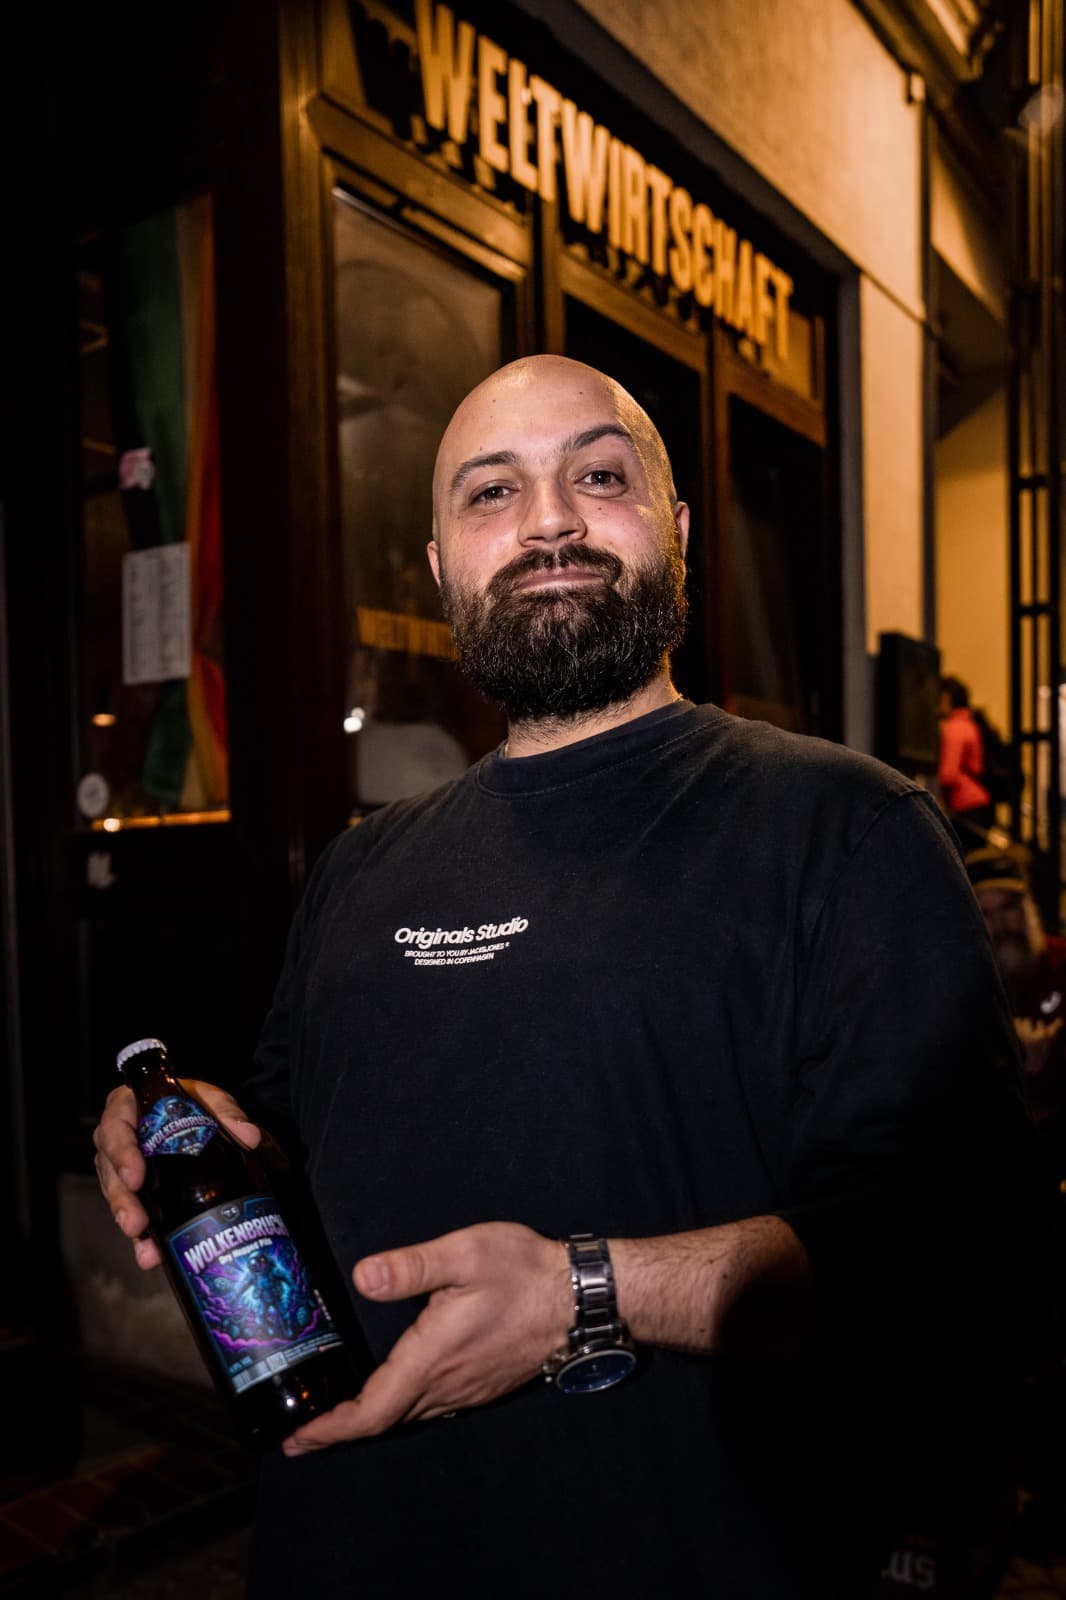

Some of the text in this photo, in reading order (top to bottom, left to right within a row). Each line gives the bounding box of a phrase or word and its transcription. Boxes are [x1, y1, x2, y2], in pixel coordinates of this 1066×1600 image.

[414, 0, 793, 361] WELTWIRTSCHAFT
[394, 916, 529, 949] Originals Studio
[404, 950, 436, 958] BROUGHT
[446, 949, 459, 957] YOU
[414, 952, 495, 966] DESIGNED IN COPENHAGEN
